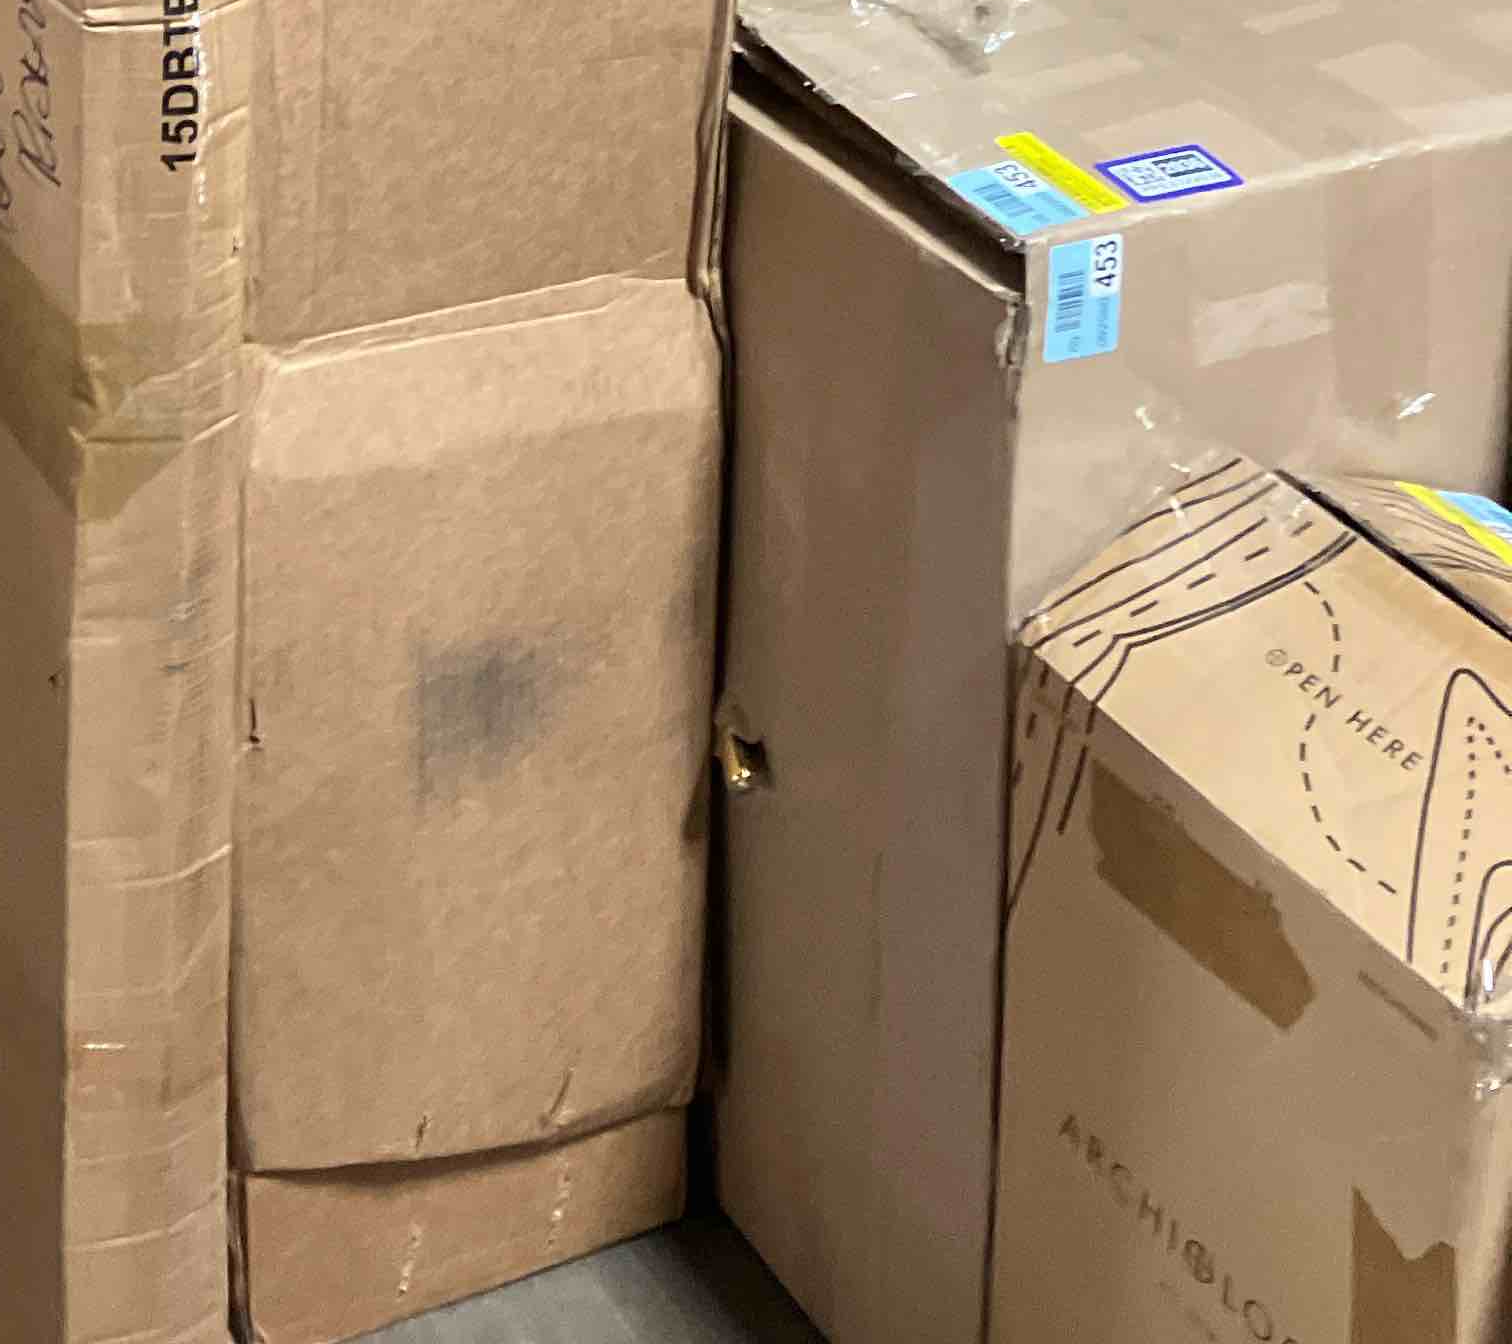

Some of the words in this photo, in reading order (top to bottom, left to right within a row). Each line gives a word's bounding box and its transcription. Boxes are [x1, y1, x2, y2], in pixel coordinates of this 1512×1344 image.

[993, 163, 1038, 191] 453
[1092, 239, 1119, 288] 453
[1344, 709, 1424, 772] HERE
[1057, 1114, 1300, 1344] ARCHIBLO
